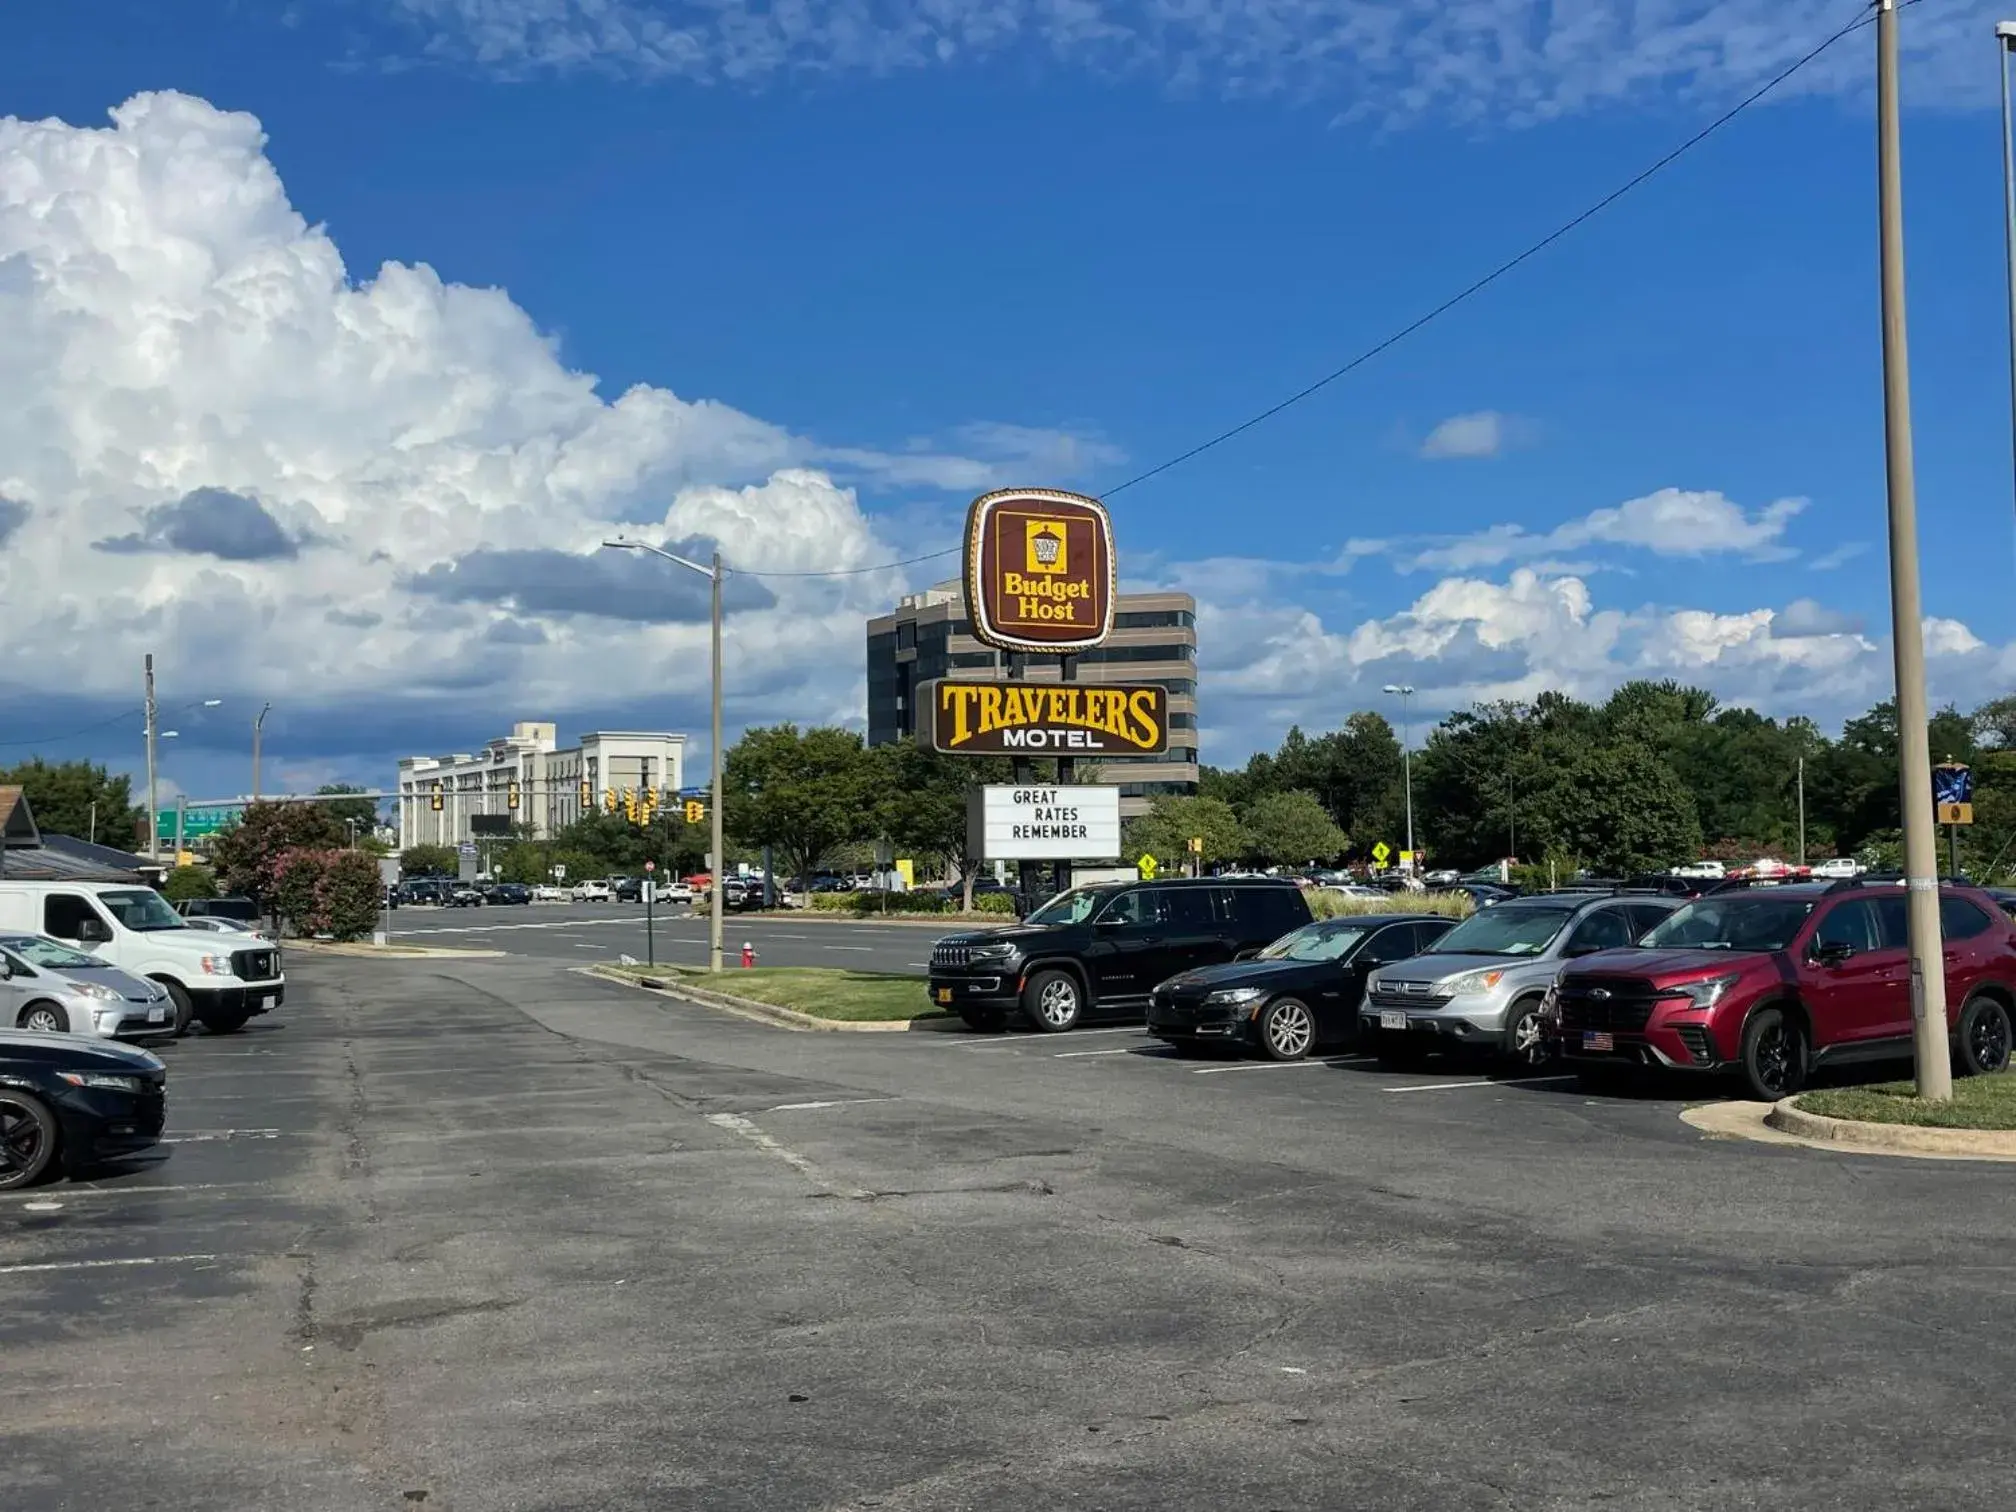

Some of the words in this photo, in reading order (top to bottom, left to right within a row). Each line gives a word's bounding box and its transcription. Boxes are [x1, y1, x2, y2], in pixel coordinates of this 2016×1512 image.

[1005, 572, 1089, 602] Budget
[1018, 596, 1074, 620] Host
[943, 685, 1159, 749] TRAVELERS
[1003, 729, 1104, 748] MOTEL
[1013, 790, 1057, 804] GREAT
[1035, 807, 1078, 821] RATES
[1013, 825, 1087, 839] REMEMBER
